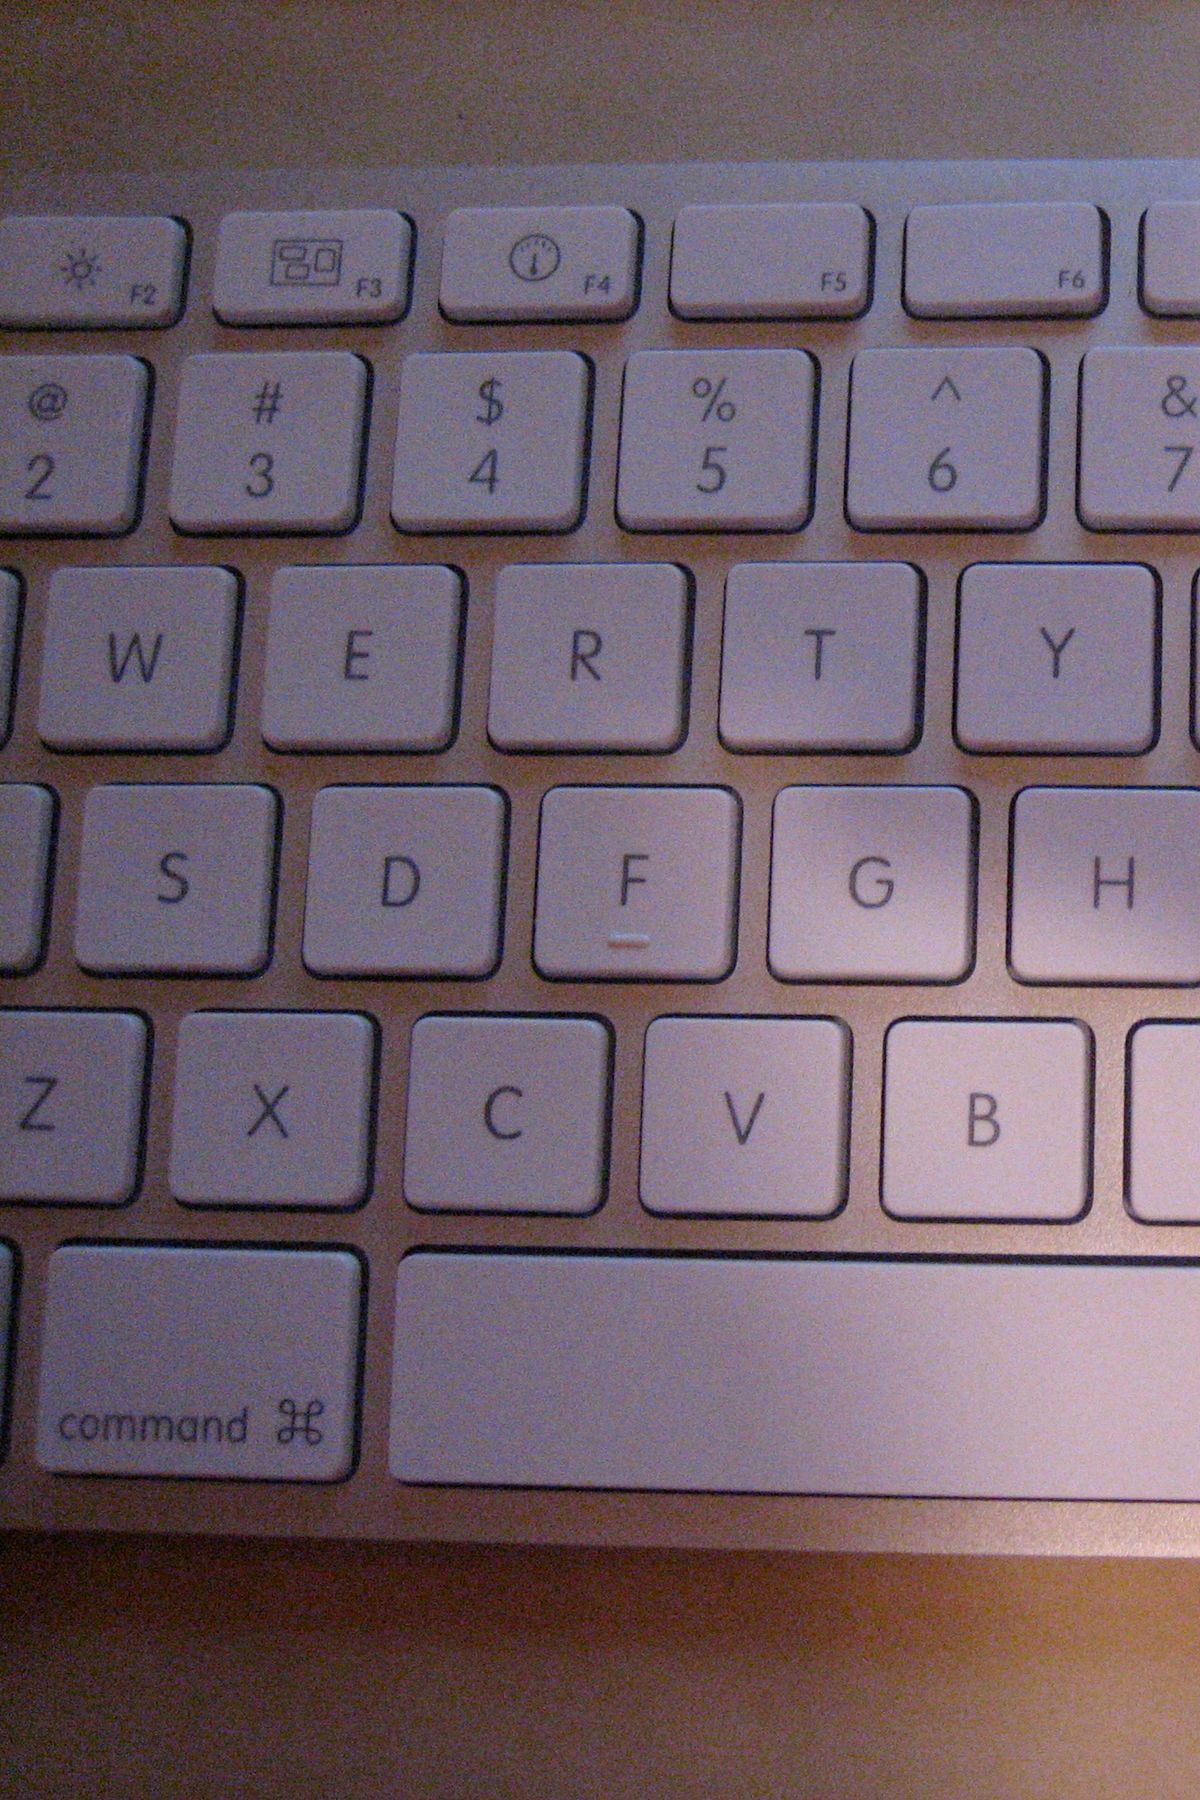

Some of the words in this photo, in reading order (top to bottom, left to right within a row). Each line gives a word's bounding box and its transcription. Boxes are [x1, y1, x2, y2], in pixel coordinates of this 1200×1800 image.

[129, 283, 158, 306] F2
[355, 277, 383, 299] F3
[583, 274, 611, 295] F4
[820, 271, 848, 293] F5
[1057, 269, 1086, 289] F6
[26, 382, 69, 423] @
[252, 381, 283, 424] #
[475, 377, 504, 427] $
[691, 376, 737, 423] %
[930, 375, 962, 402] ^
[1160, 374, 1198, 419] &
[24, 453, 56, 501] 2
[245, 451, 275, 499] 3
[468, 448, 499, 495] 4
[696, 446, 727, 495] 5
[927, 446, 958, 494] 6
[1163, 445, 1195, 493] 7
[108, 632, 164, 684] W
[343, 629, 374, 681] E
[569, 629, 603, 682] R
[803, 628, 836, 681] T
[1039, 627, 1076, 679] Y
[156, 851, 190, 905] S
[380, 855, 422, 909] D
[619, 853, 649, 907] F
[847, 855, 895, 910] G
[1092, 856, 1136, 910] H
[18, 1075, 59, 1132] Z
[246, 1083, 290, 1139] X
[483, 1085, 524, 1141] C
[723, 1091, 766, 1146] V
[966, 1091, 1001, 1148] B
[57, 1406, 249, 1445] command
